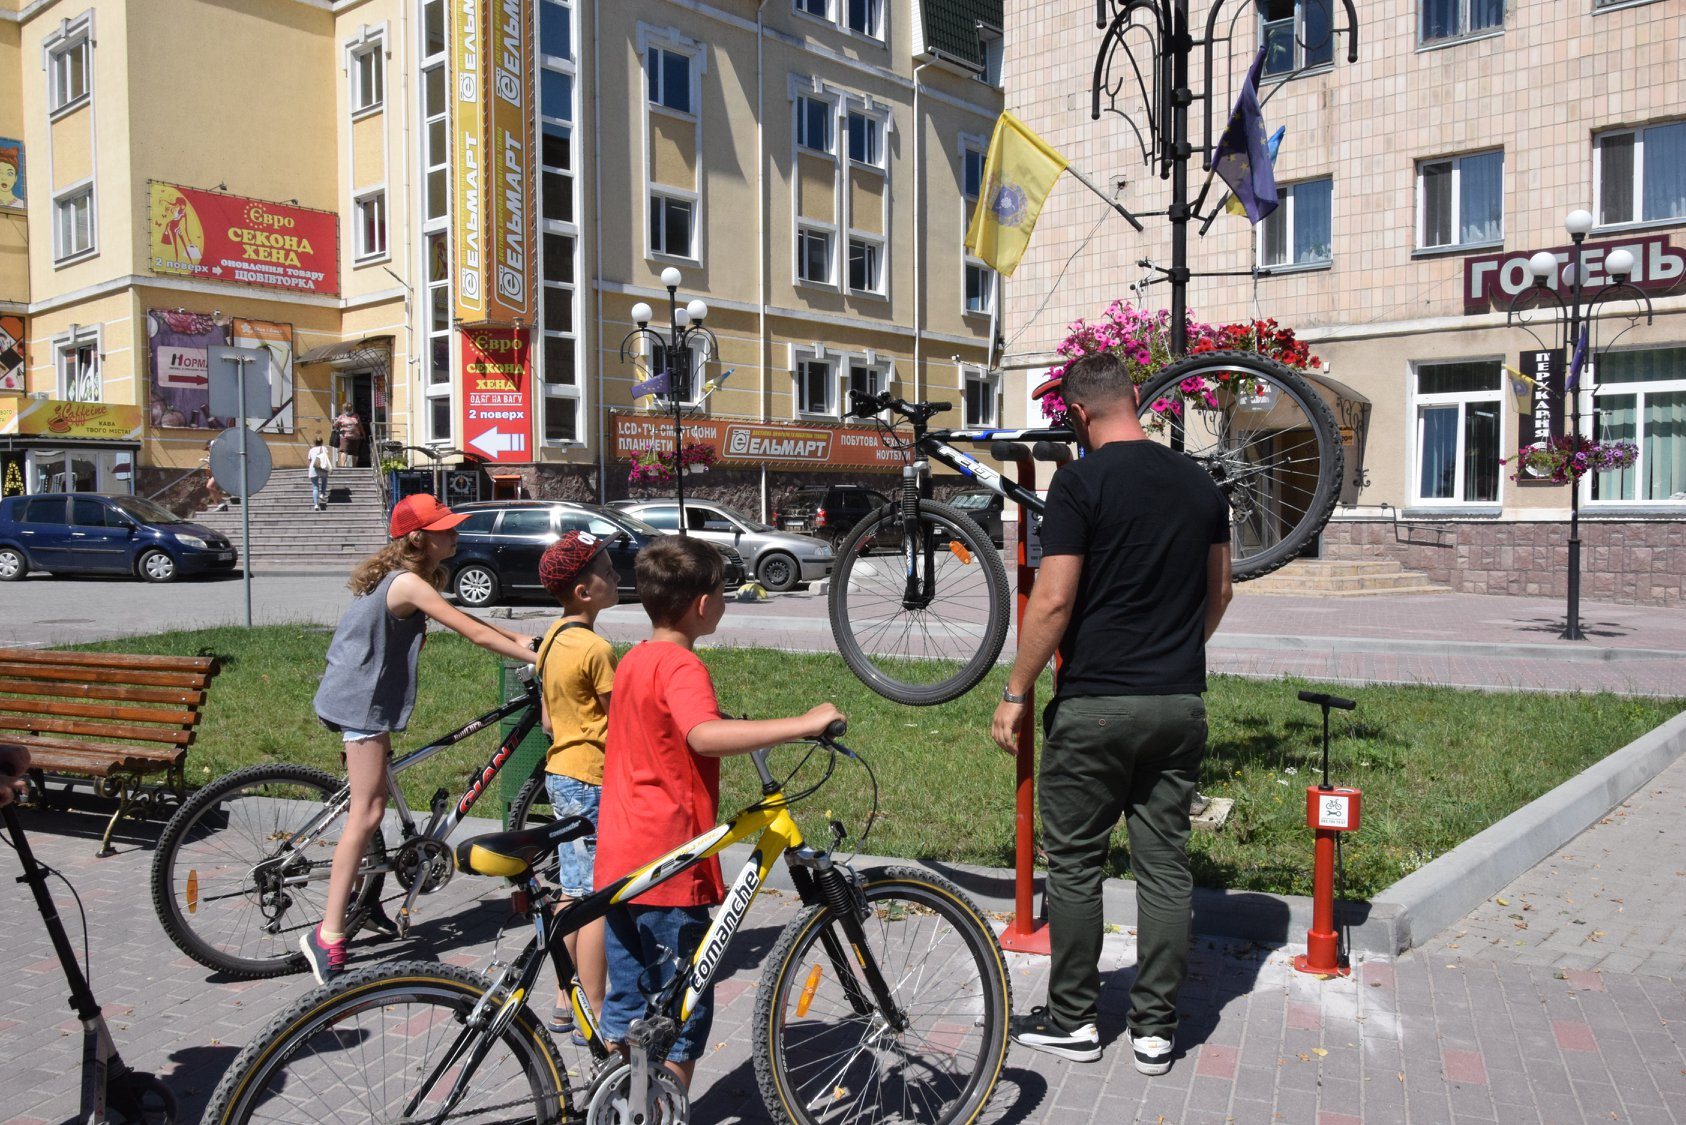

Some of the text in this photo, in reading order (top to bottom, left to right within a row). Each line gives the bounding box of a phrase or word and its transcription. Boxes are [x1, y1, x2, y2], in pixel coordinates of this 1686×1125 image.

[465, 131, 479, 268] ЕЛЬМАРТ
[505, 130, 523, 272] ЕЛЬМАРТ
[250, 207, 295, 229] Євро
[227, 227, 314, 255] СЕКОНД
[155, 257, 209, 274] 2 поверх
[242, 244, 301, 268] ХЕНД
[220, 258, 325, 281] оновлення товару
[234, 269, 315, 290] ЩОВІВТОРКА
[1471, 241, 1686, 298] ГОТЕЛЬ
[476, 336, 522, 353] Євро
[466, 363, 526, 375] СЕКОНД
[476, 379, 517, 391] ХЕНД
[1535, 353, 1551, 438] ПЕРУКАРНЯ
[470, 395, 522, 403] ОДЯГ НА ВАГУ
[62, 403, 107, 426] Caffeine
[469, 410, 524, 420] 2 поверх
[618, 422, 637, 435] LCD
[749, 438, 826, 457] ЕЛЬМАРТ
[841, 434, 879, 447] ПОБУТОВА
[937, 446, 999, 480] FELT
[459, 728, 520, 813] GIANT
[690, 870, 760, 994] comanche
